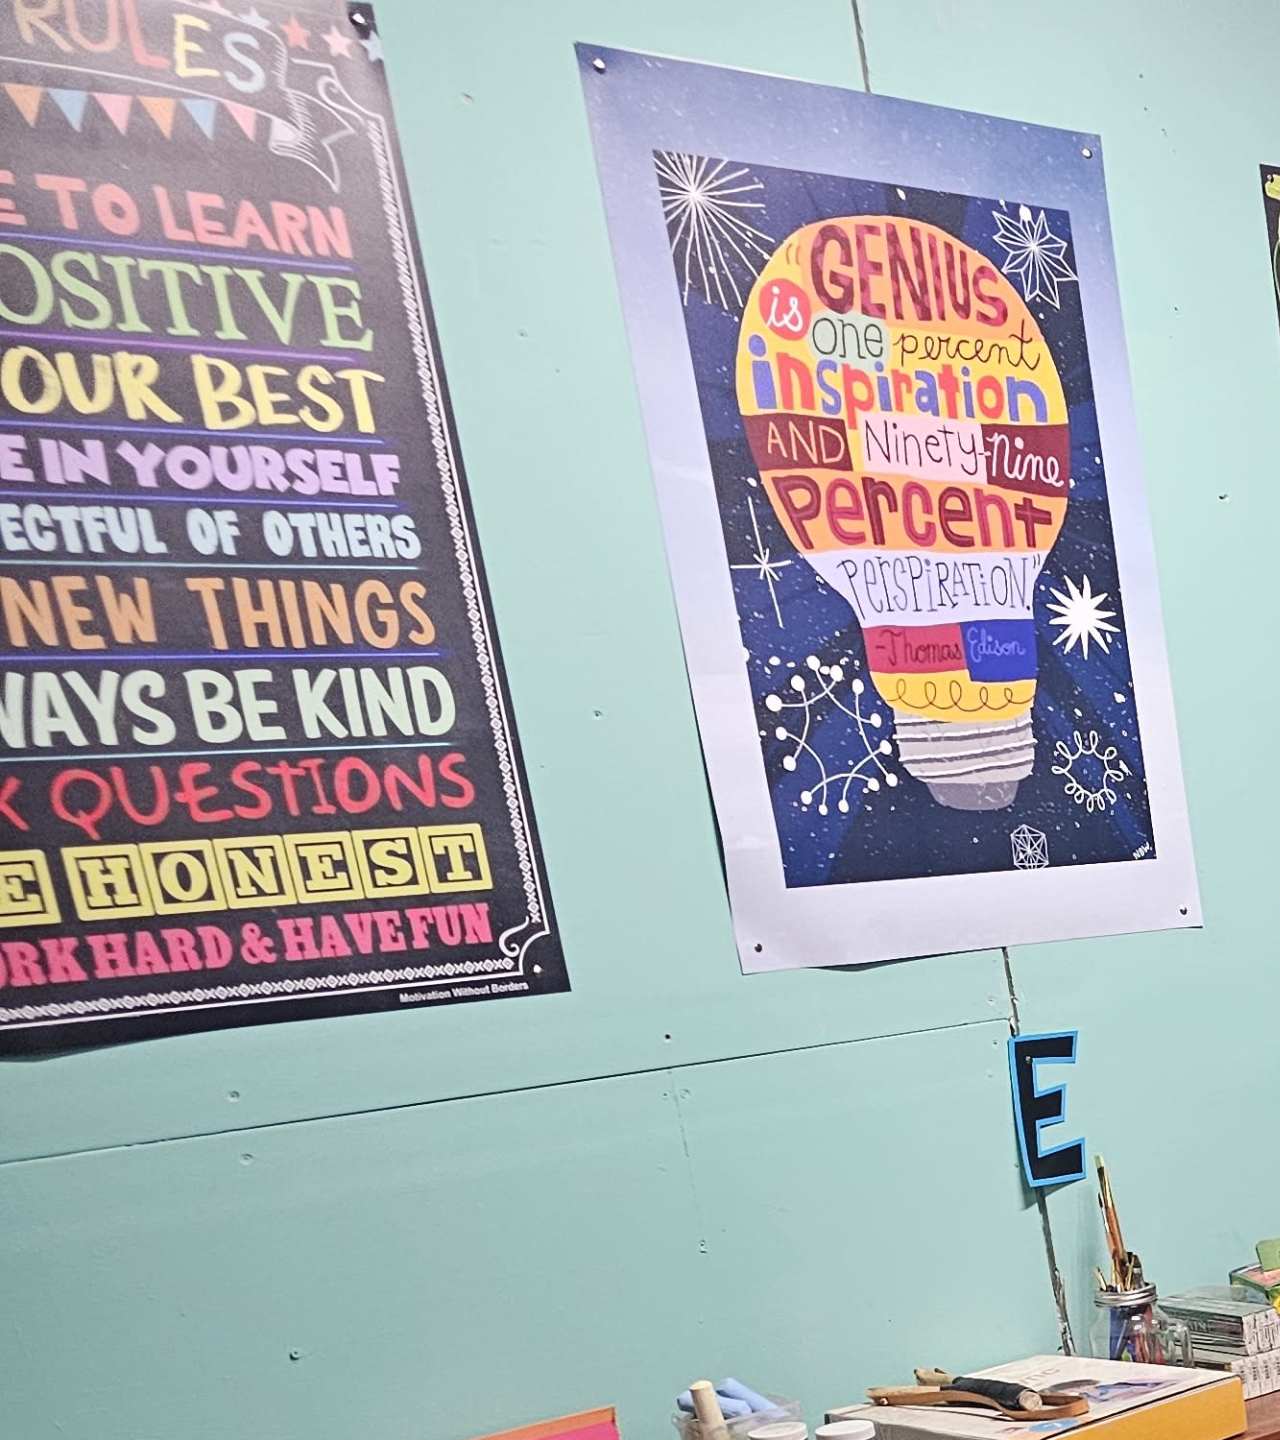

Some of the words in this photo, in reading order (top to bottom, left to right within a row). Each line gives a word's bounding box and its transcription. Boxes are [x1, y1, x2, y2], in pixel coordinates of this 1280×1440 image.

[14, 0, 269, 94] RULES
[36, 173, 141, 236] TO
[154, 184, 353, 259] LEARN
[764, 286, 804, 333] is
[812, 317, 884, 360] one
[893, 320, 1041, 370] percent
[192, 354, 385, 434] BEST
[748, 333, 1048, 430] inspiration
[41, 440, 111, 487] IN
[115, 443, 400, 497] YOURSELF
[767, 421, 847, 465] AND
[187, 509, 242, 558] OF
[262, 509, 423, 560] OTHERS
[185, 577, 437, 652] THINGS
[184, 668, 286, 744] BE
[293, 665, 457, 741] KIND
[49, 753, 476, 841] QUESTIONS
[64, 826, 491, 917] HONEST
[86, 924, 234, 980] HARD
[240, 924, 277, 965] &
[277, 909, 406, 960] HAVE
[405, 902, 493, 949] FUN
[399, 990, 451, 1003] Motivation
[452, 984, 490, 999] Without
[491, 980, 530, 995] Borders
[1007, 1030, 1087, 1189] E
